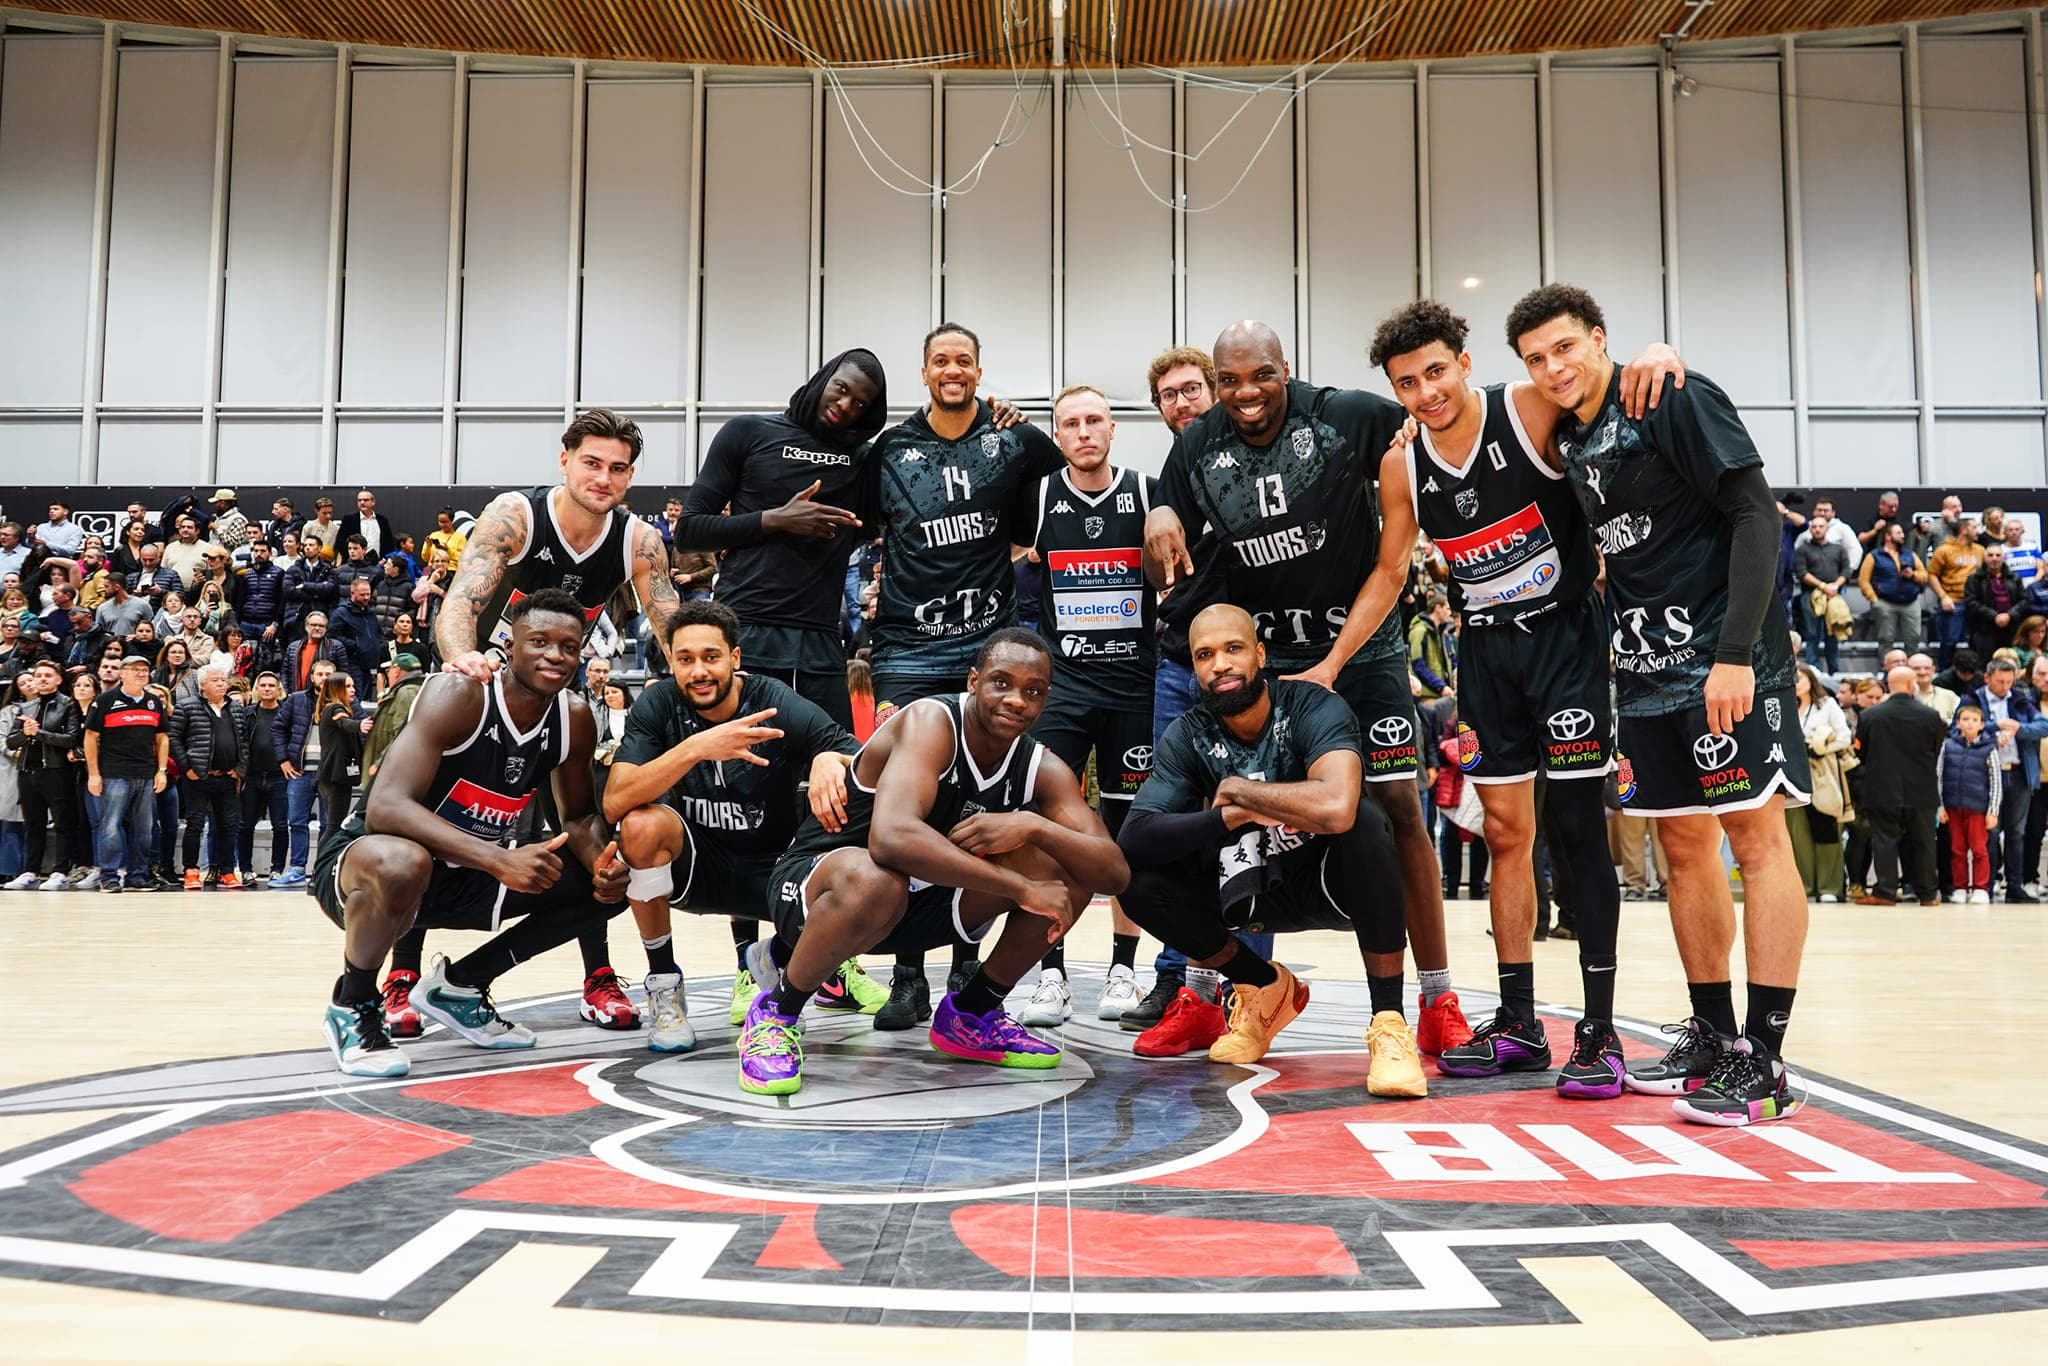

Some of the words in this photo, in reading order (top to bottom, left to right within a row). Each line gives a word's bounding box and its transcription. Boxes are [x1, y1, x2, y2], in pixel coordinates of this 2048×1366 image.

[782, 446, 850, 465] Kappa
[1486, 440, 1508, 471] 0
[942, 466, 972, 501] 14
[1255, 473, 1288, 518] 13
[1116, 493, 1135, 513] 88
[920, 512, 984, 548] TOURS
[1593, 512, 1637, 554] OURS
[1232, 525, 1309, 568] TOURS
[1454, 528, 1528, 568] ARTUS
[1063, 560, 1128, 577] ARTUS
[1471, 560, 1505, 576] interim
[1508, 550, 1526, 562] CDD
[1077, 576, 1105, 585] interim
[1074, 615, 1120, 624] FONDETTES
[1648, 646, 1696, 671] Services
[1370, 746, 1417, 761] TOYOTA
[1549, 739, 1601, 756] TOYOTA
[1121, 771, 1151, 783] TOY
[1699, 767, 1750, 788] TOYOTA
[682, 795, 749, 831] TOURS
